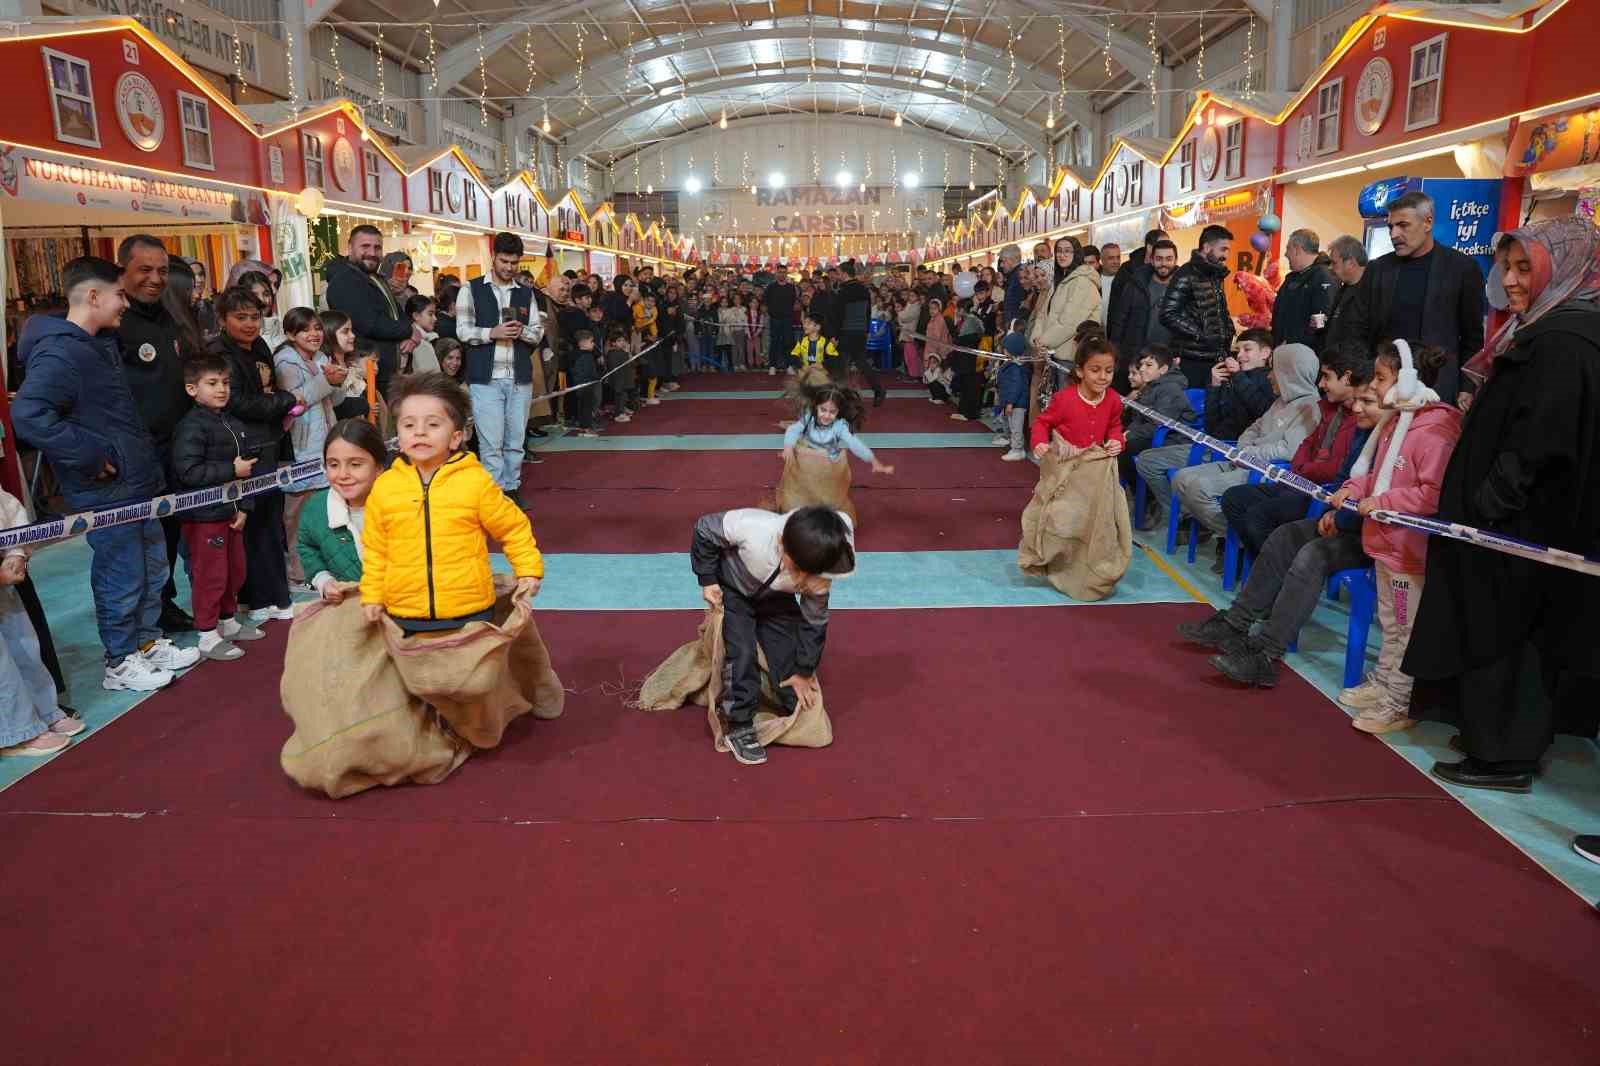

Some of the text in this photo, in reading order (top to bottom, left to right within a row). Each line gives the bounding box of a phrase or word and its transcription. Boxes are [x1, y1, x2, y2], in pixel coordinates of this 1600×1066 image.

[125, 44, 138, 61] 21
[22, 156, 124, 190] NURCİHAN
[757, 187, 880, 206] RAMAZAN
[1457, 220, 1479, 242] iyi
[18, 520, 64, 544] MÜDÜRLÜĞÜ
